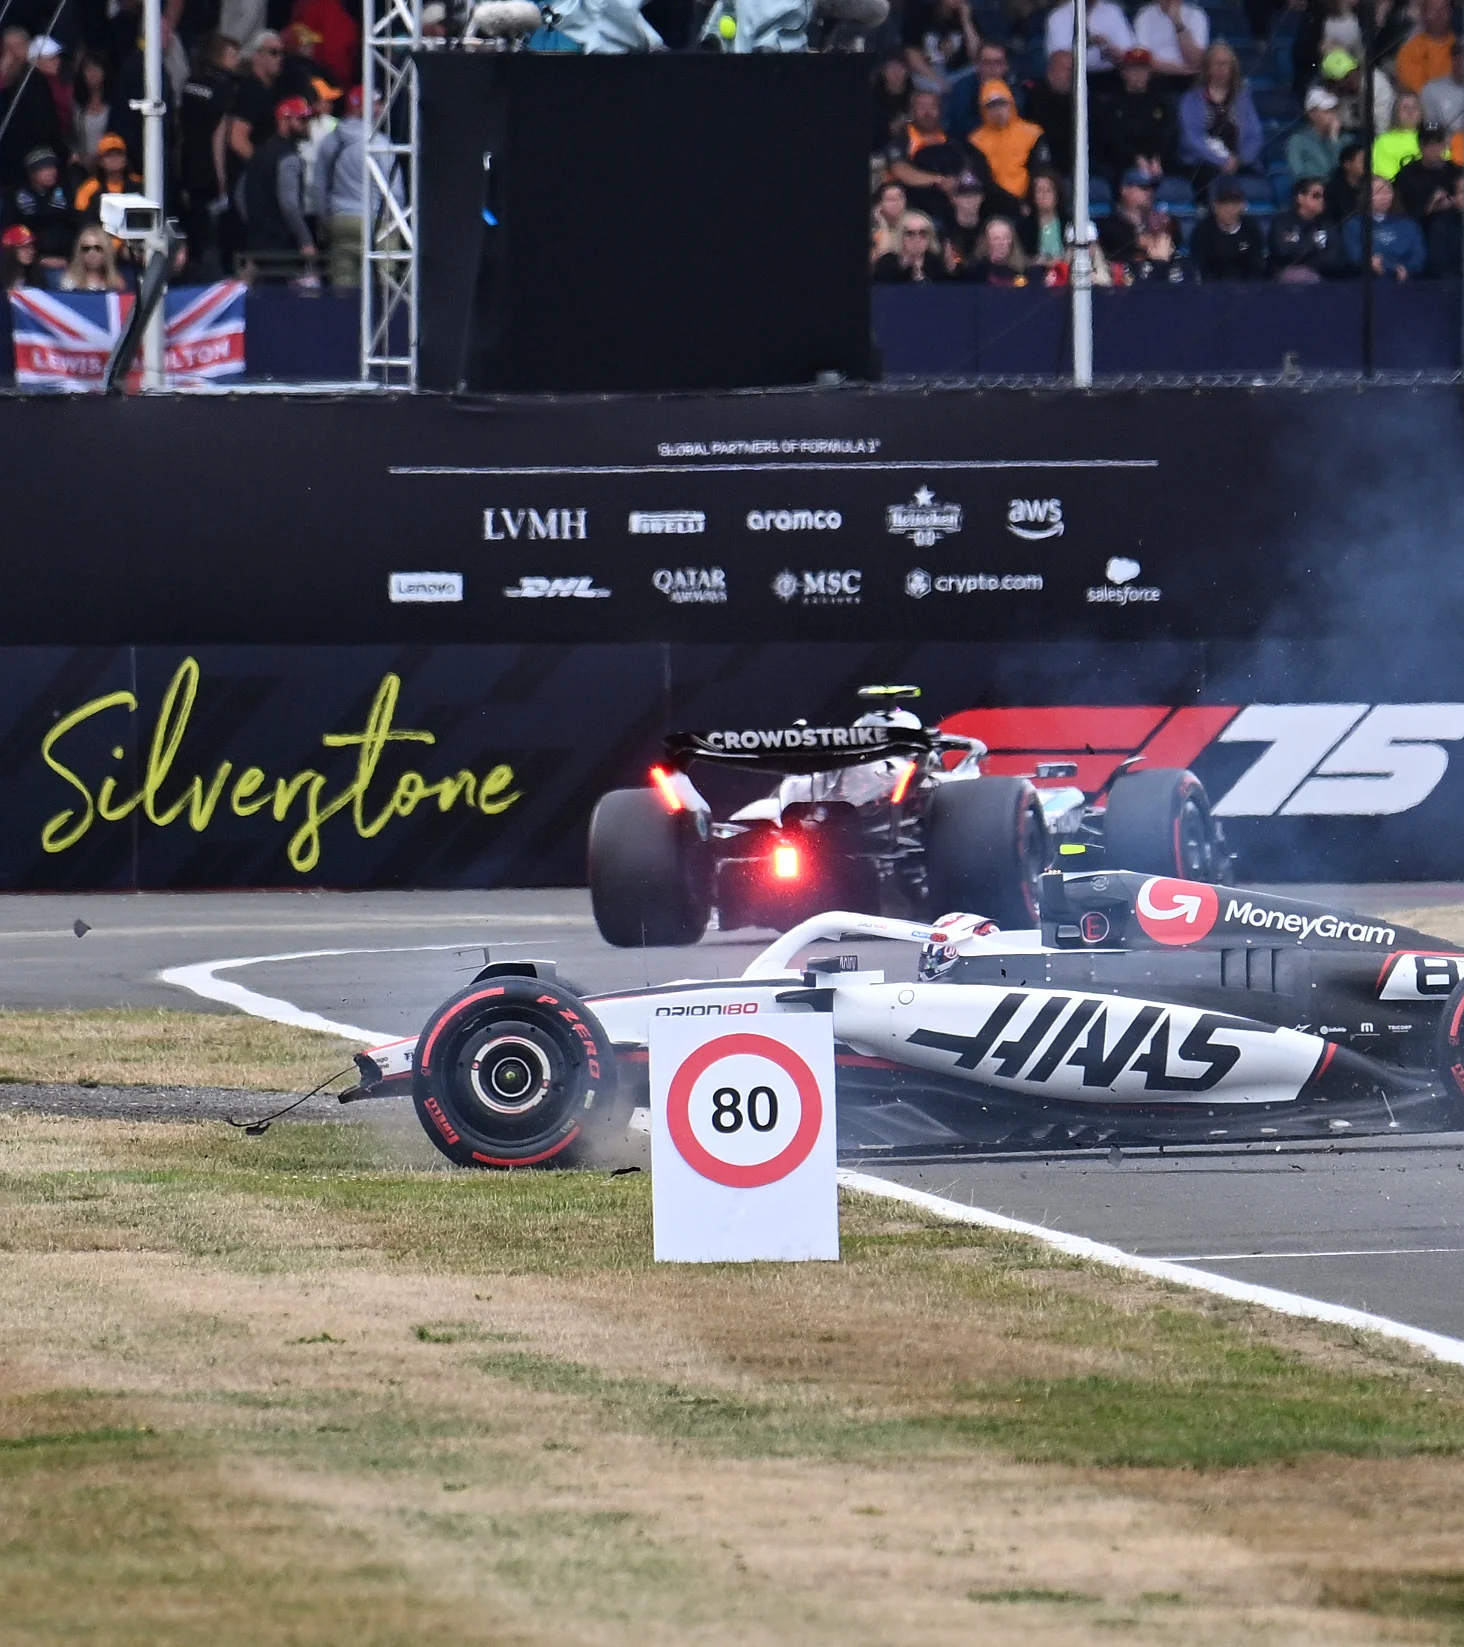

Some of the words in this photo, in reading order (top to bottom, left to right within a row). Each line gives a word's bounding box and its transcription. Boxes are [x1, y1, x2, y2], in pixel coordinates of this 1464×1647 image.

[31, 347, 106, 375] LEWIS
[658, 442, 710, 457] GLOBAL
[711, 440, 780, 455] PARTNERS
[780, 439, 799, 453] OF
[800, 438, 866, 453] FORMULA
[483, 507, 588, 540] LVMH
[746, 509, 842, 531] aramco
[1008, 499, 1062, 522] aws
[398, 580, 456, 595] Lenovo
[652, 566, 727, 594] QATAR
[803, 568, 862, 595] MSC
[935, 573, 1044, 593] crypto.com
[1085, 585, 1161, 606] salesforce
[706, 727, 889, 751] CROWDSTRIKE
[41, 656, 523, 872] Silverstone
[1224, 898, 1396, 945] MoneyGram
[558, 1007, 601, 1080] ZERO
[906, 993, 1242, 1092] HAAS
[711, 1086, 779, 1133] 80
